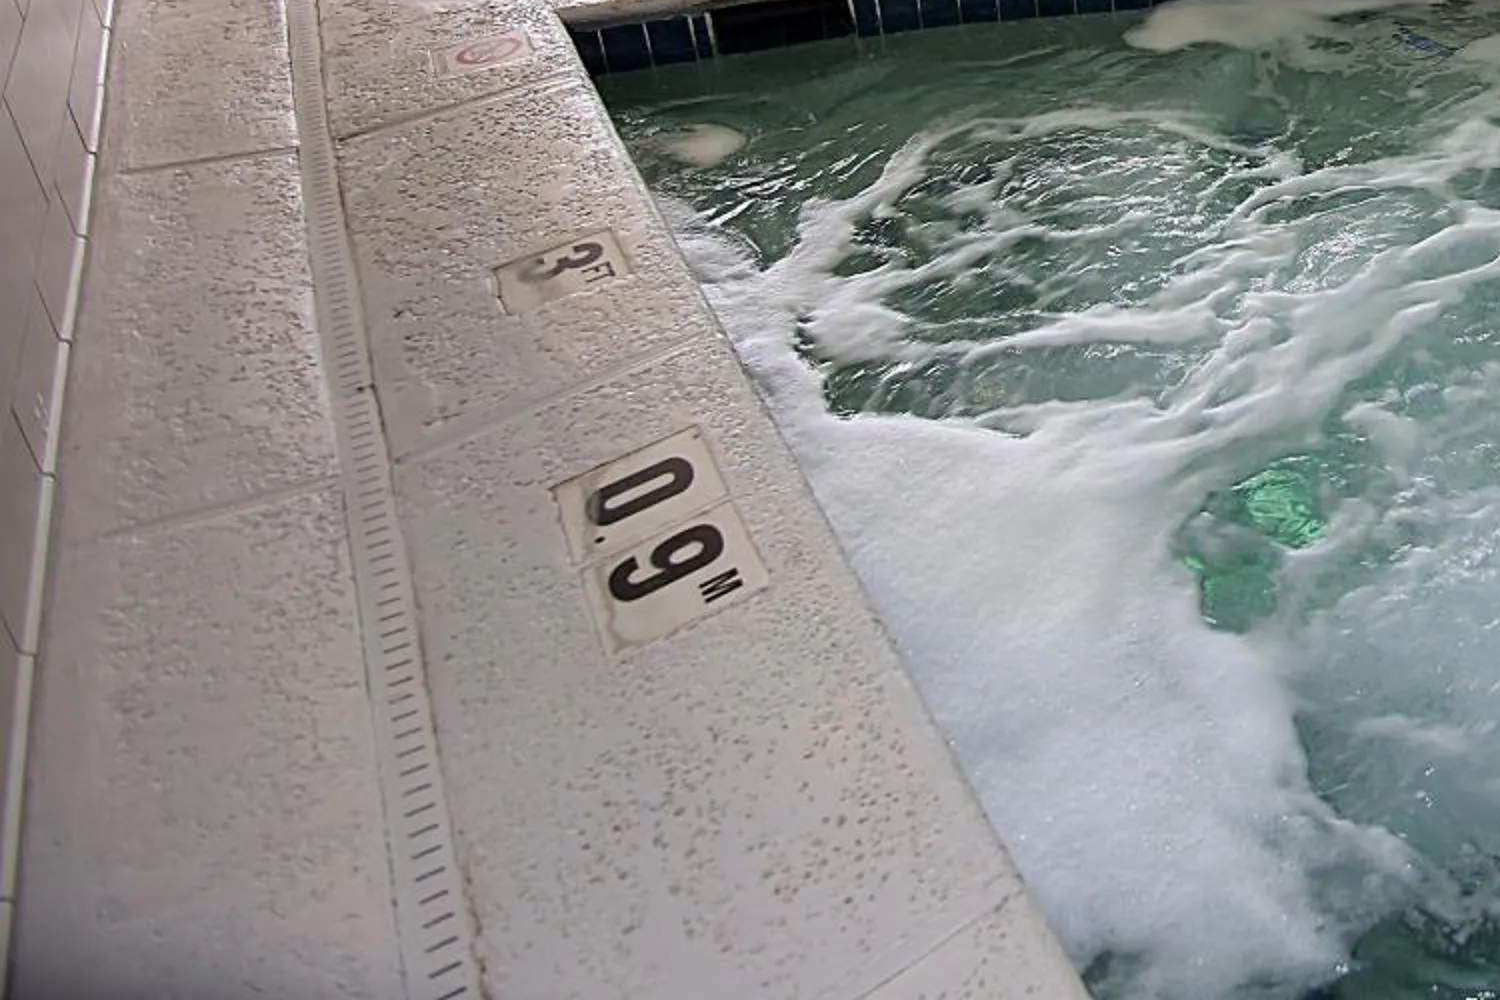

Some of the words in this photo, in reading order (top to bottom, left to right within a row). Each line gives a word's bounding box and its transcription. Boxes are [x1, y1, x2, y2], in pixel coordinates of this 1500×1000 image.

[516, 241, 604, 284] 3
[581, 260, 617, 284] FT
[585, 456, 725, 604] 0.9
[697, 566, 744, 605] M
